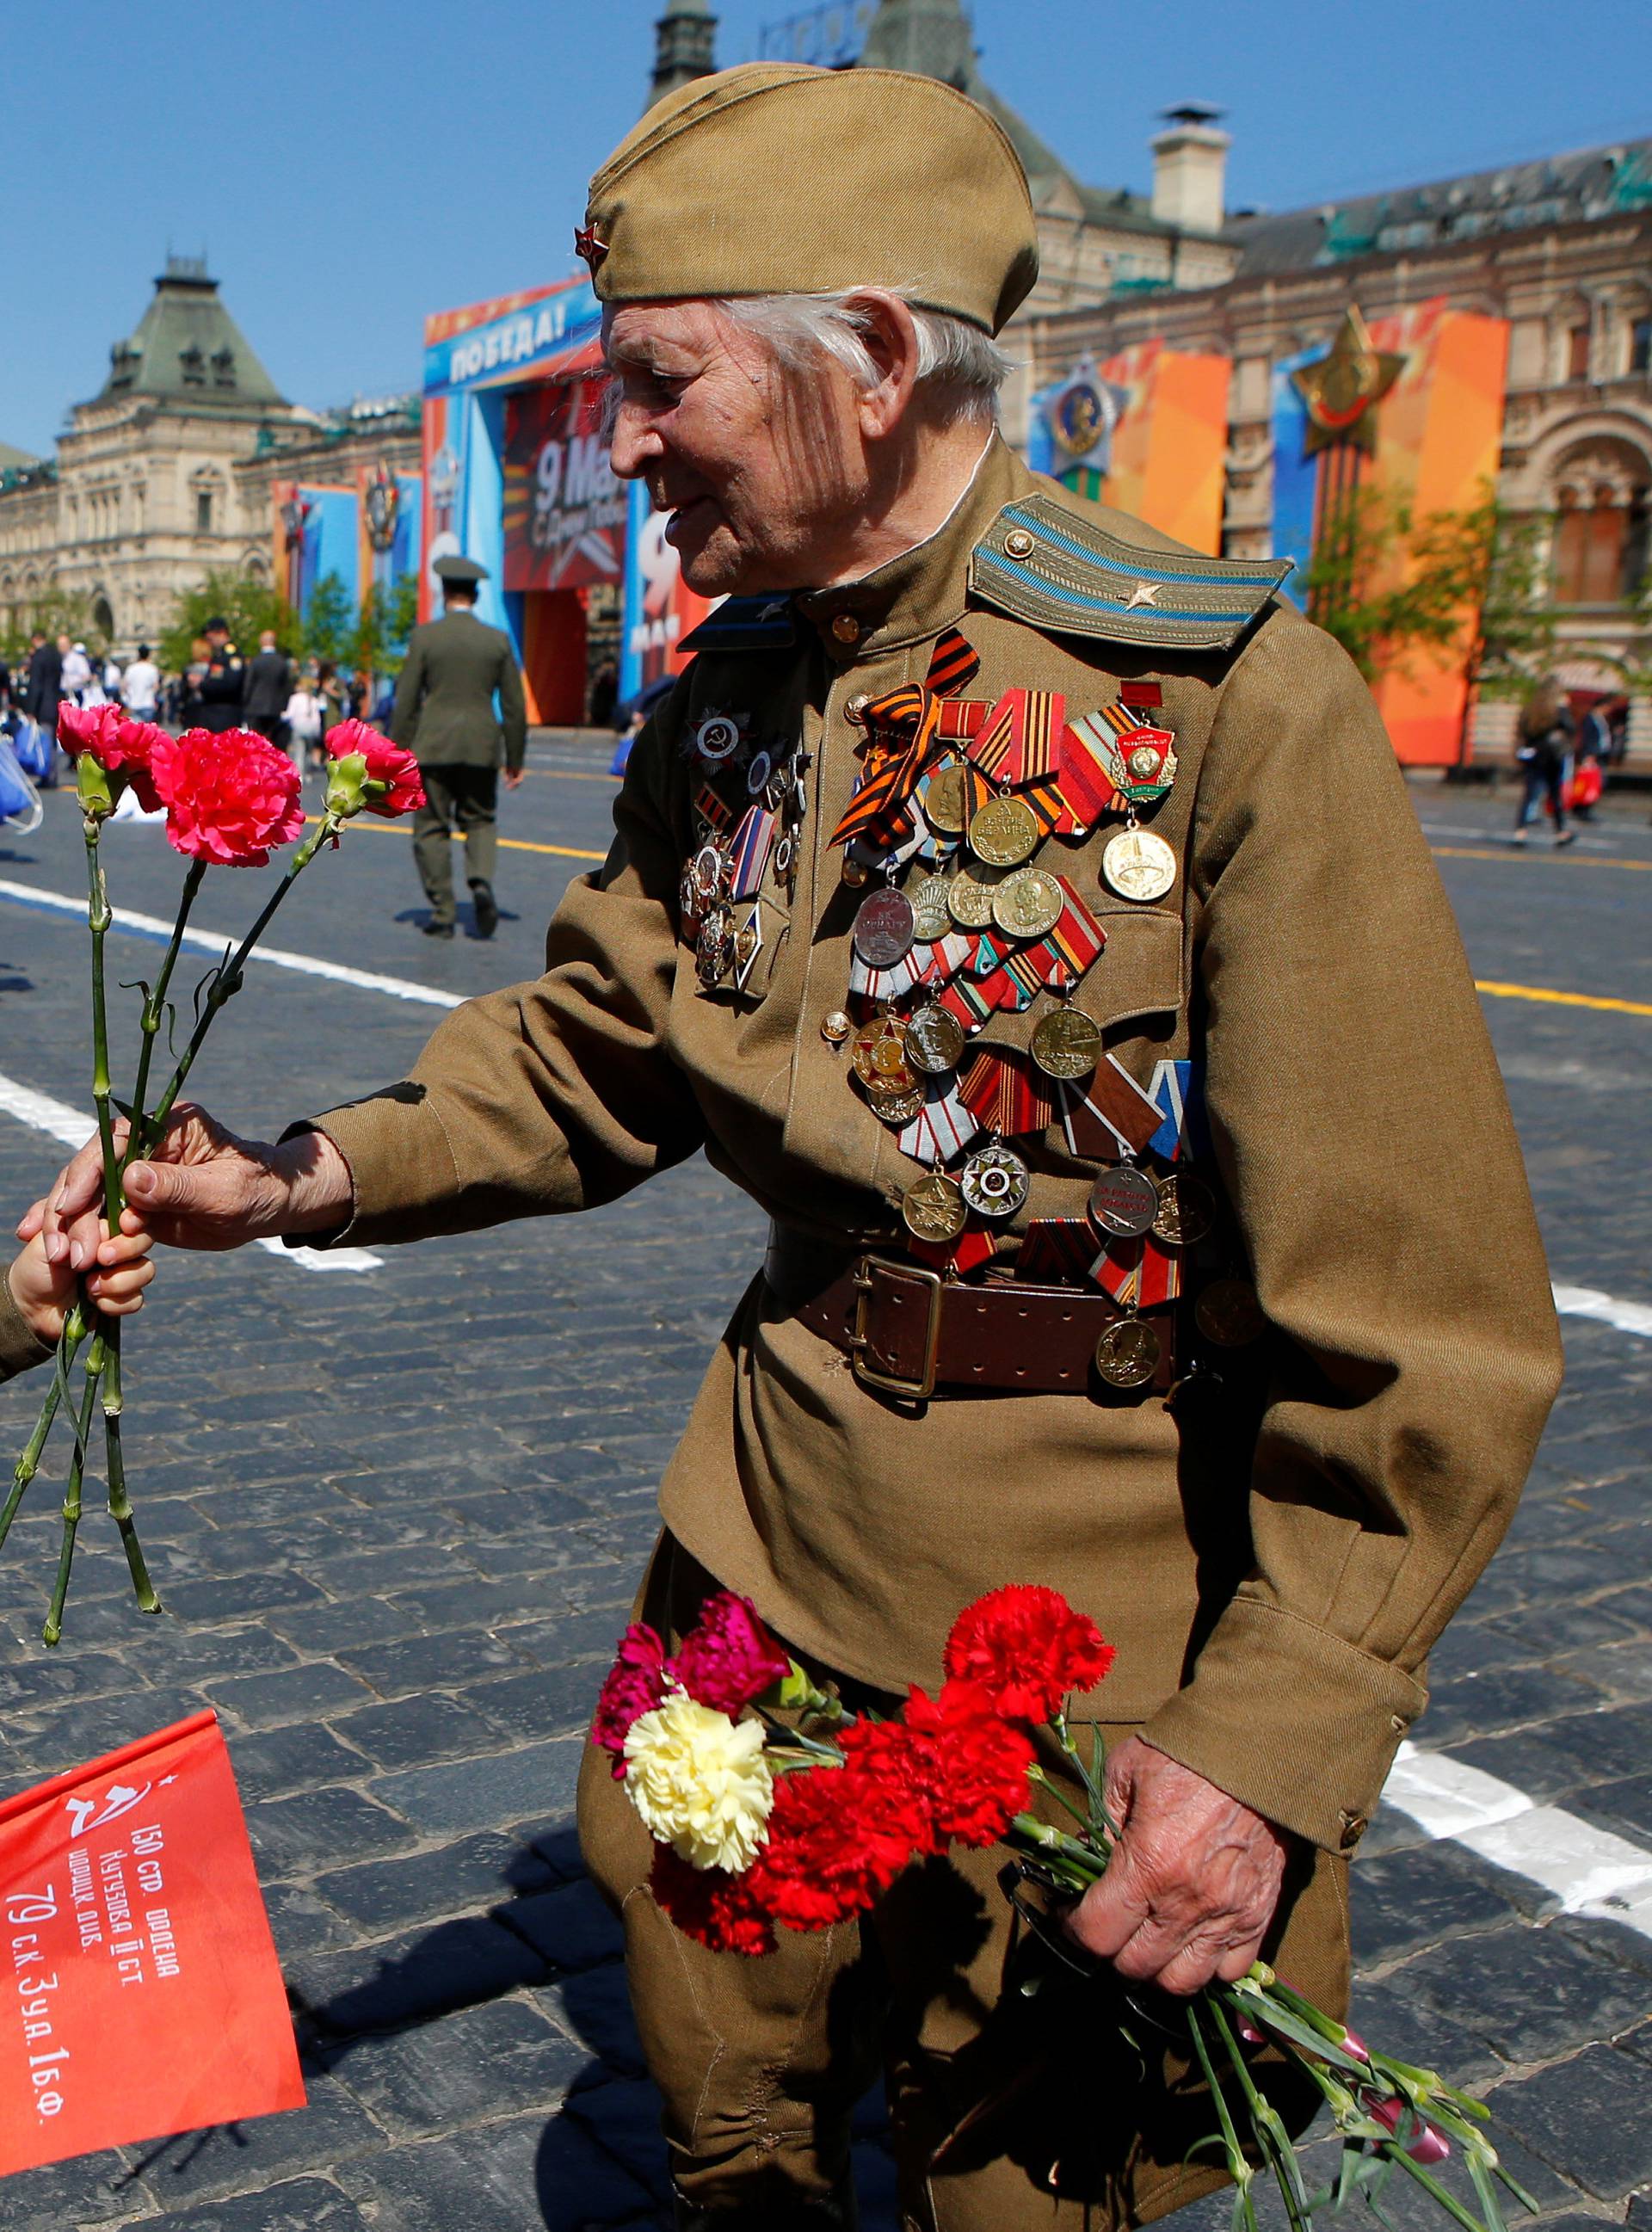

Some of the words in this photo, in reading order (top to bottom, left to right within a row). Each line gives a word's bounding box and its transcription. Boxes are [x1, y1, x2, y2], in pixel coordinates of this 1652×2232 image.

[449, 301, 566, 385] ПОБЕДА!
[535, 440, 561, 511] 9
[638, 509, 680, 615] 9
[131, 1823, 164, 1856] 150
[137, 1860, 163, 1897] СТР.
[4, 1884, 58, 1924] 79
[145, 1908, 181, 1978] ОРДЕНА
[18, 1972, 59, 1996] 3
[28, 2046, 70, 2067] 1
